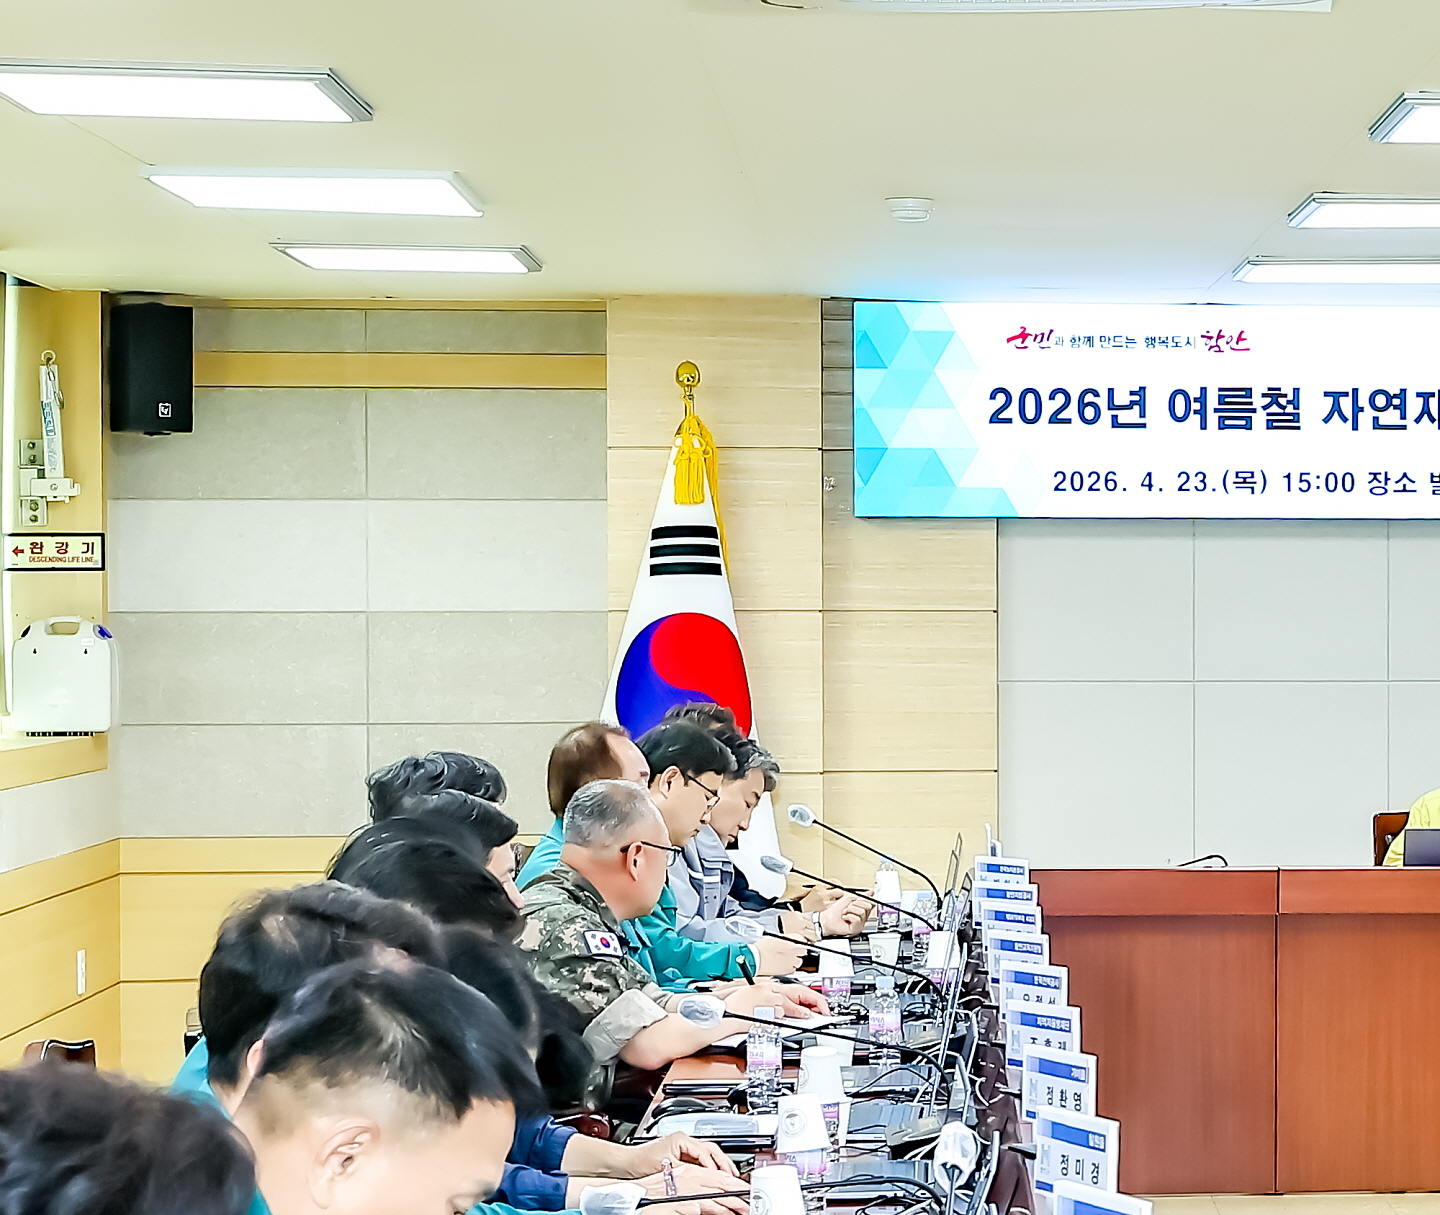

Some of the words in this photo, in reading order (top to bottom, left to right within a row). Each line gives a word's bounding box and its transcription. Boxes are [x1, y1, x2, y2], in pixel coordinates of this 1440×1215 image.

[1070, 335, 1094, 349] 함께
[1100, 335, 1137, 349] 만드는
[1144, 335, 1196, 349] 행복도시
[1201, 329, 1250, 353] 함안
[988, 386, 1147, 430] 2026년
[1167, 386, 1302, 431] 여름철
[1053, 470, 1127, 492] 2026.
[1140, 471, 1163, 492] 4.
[1177, 469, 1268, 495] 23.(목)
[1282, 471, 1355, 493] 15:00
[1367, 471, 1418, 496] 장소
[1060, 1154, 1100, 1186] 정미경
